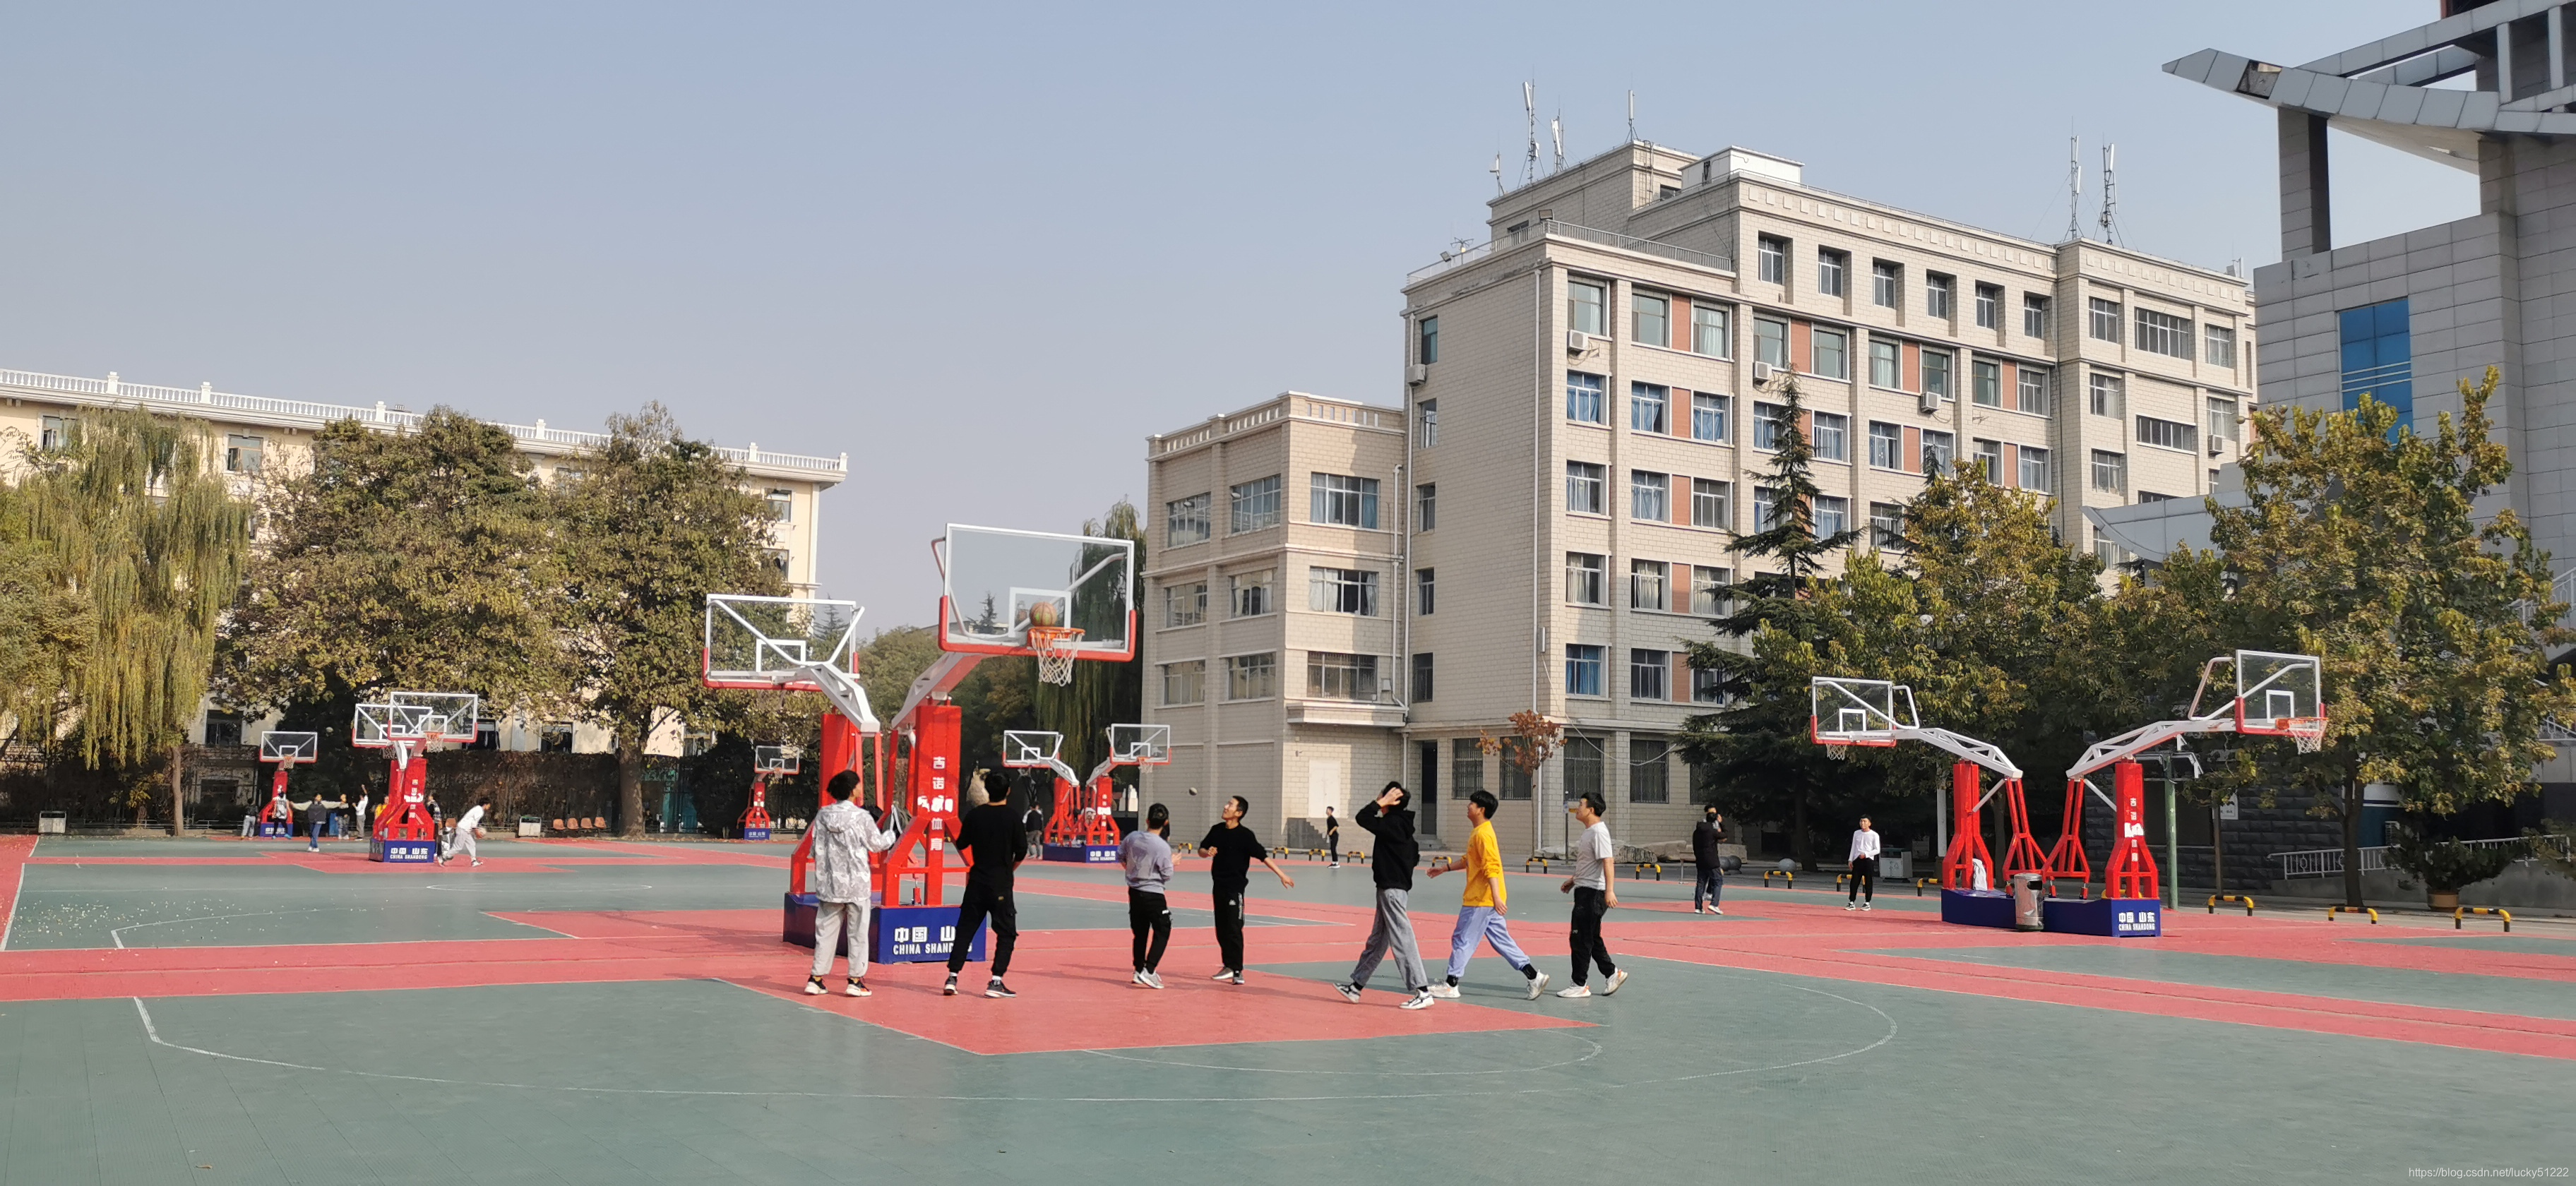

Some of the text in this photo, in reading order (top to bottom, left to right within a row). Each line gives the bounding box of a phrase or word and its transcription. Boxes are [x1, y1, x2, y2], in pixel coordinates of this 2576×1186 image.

[930, 756, 946, 851] 吉诺体育
[2118, 911, 2155, 923] 中国 山东
[895, 926, 927, 942] 中国
[893, 944, 921, 954] CHINA
